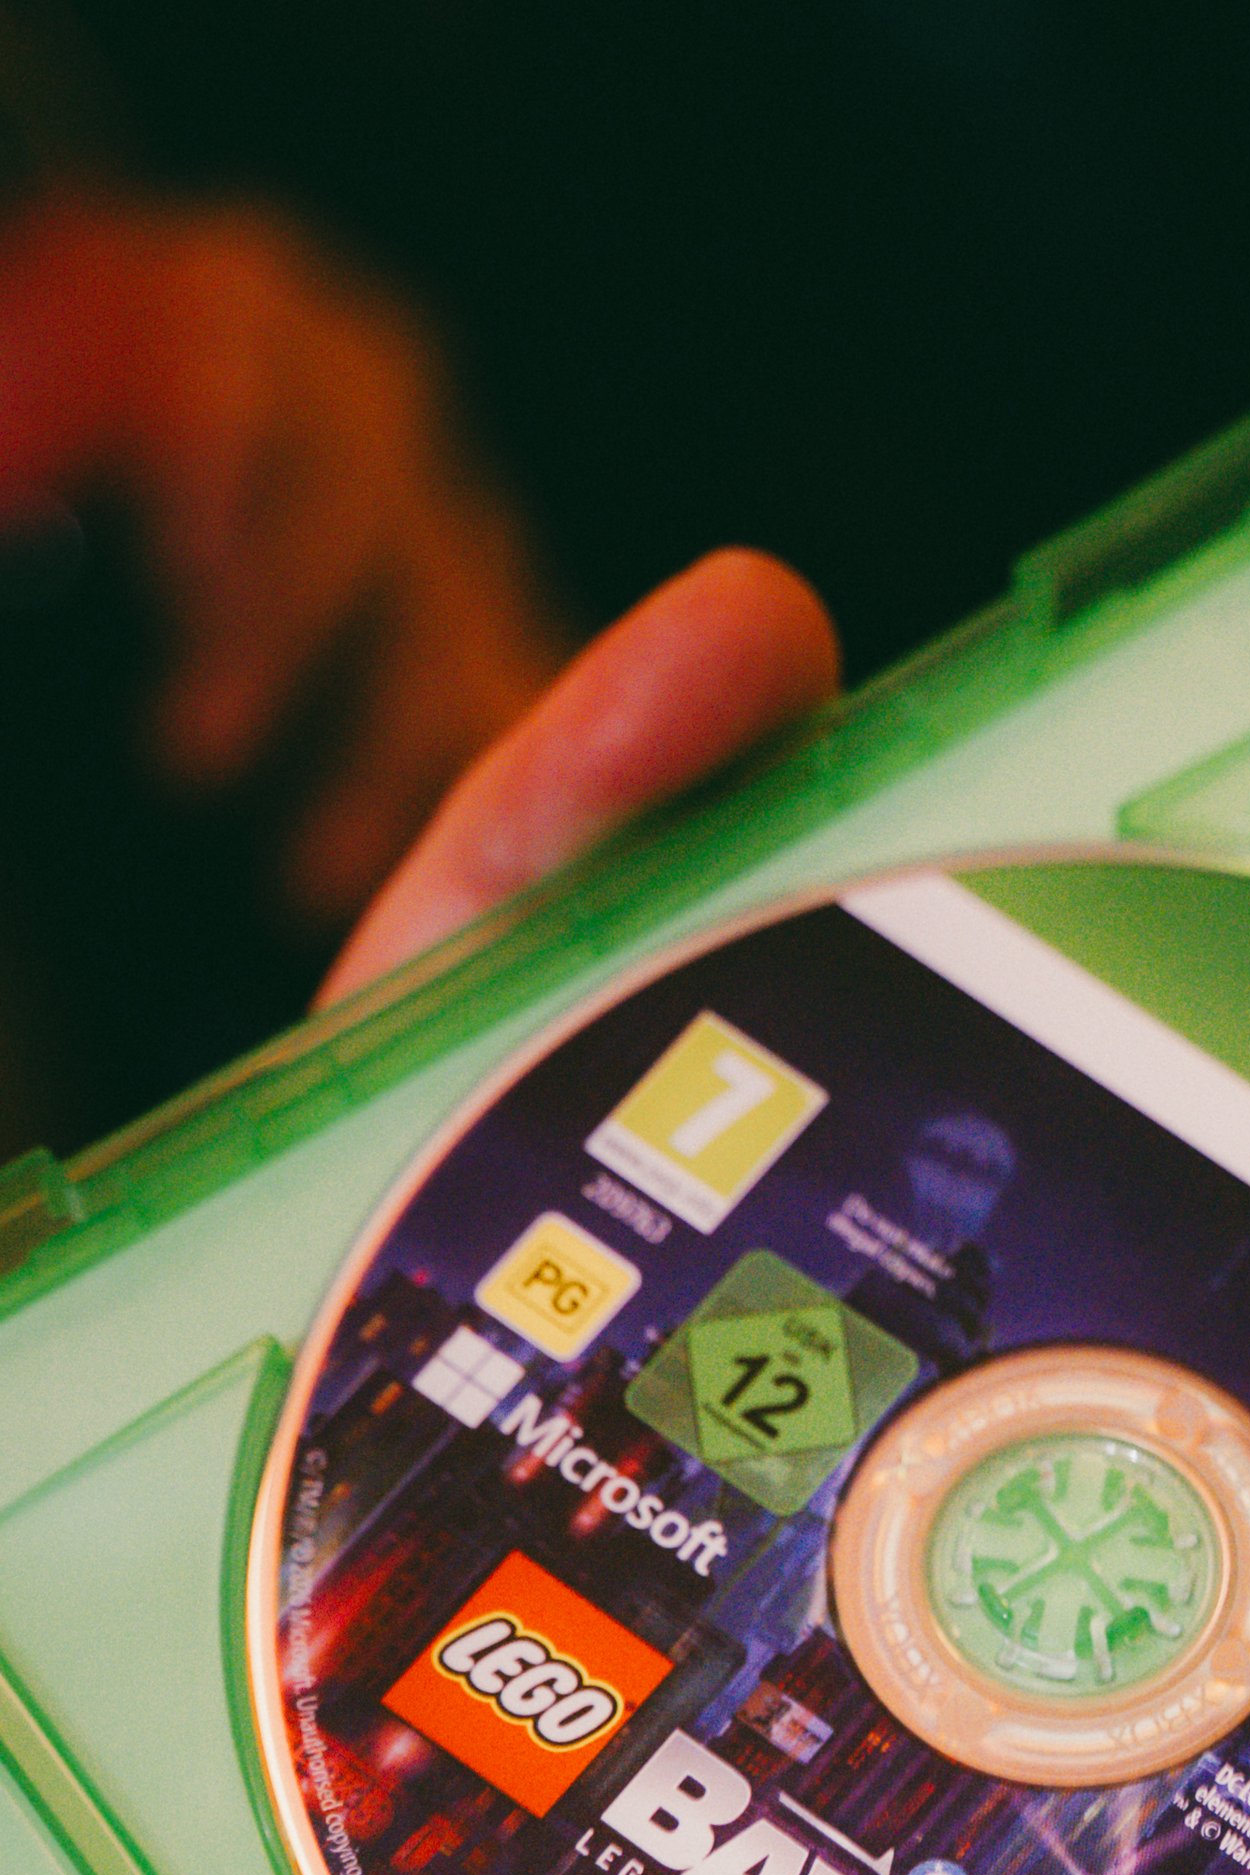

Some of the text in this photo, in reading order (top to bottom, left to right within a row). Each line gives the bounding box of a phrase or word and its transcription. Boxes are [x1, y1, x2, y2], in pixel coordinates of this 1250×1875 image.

[670, 1049, 776, 1158] 7
[523, 1259, 589, 1317] PG
[720, 1354, 809, 1440] 12
[501, 1393, 728, 1577] Microsoft
[436, 1615, 620, 1748] LEGO
[296, 1695, 343, 1812] Unauthorised
[1215, 1764, 1244, 1796] DC
